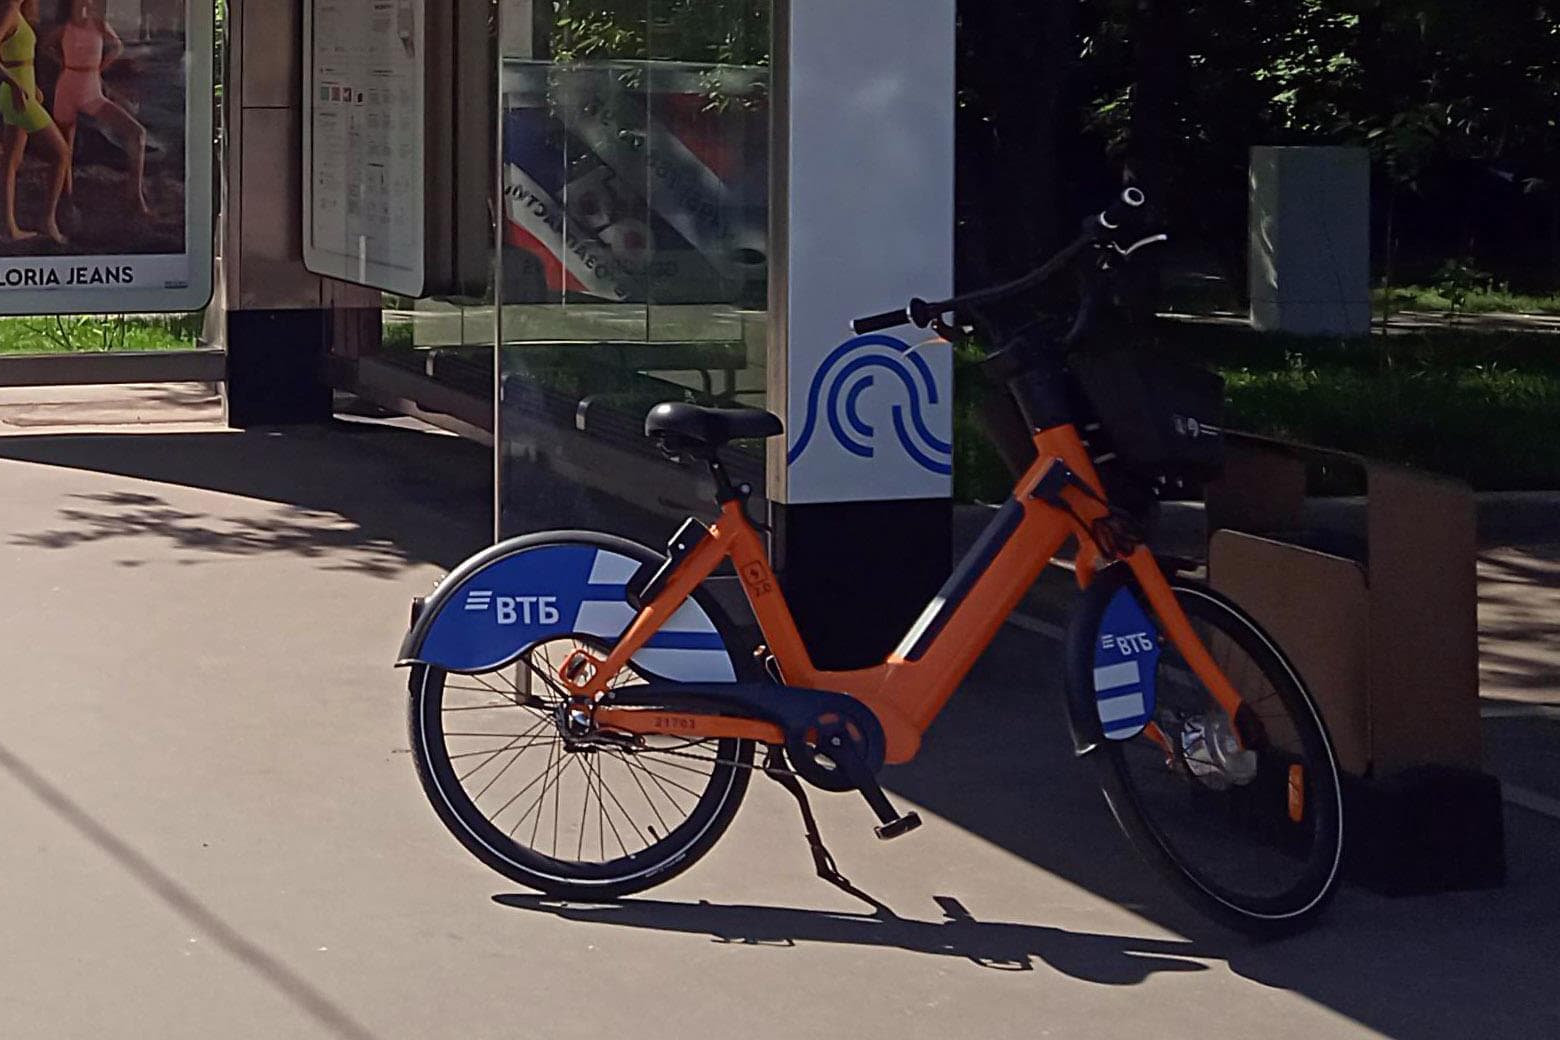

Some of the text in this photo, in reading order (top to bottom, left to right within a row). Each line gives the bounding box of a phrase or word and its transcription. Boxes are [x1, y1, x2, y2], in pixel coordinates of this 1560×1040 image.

[66, 266, 134, 285] JEANS
[497, 596, 560, 625] ВТБ
[1117, 632, 1153, 656] ВТБ
